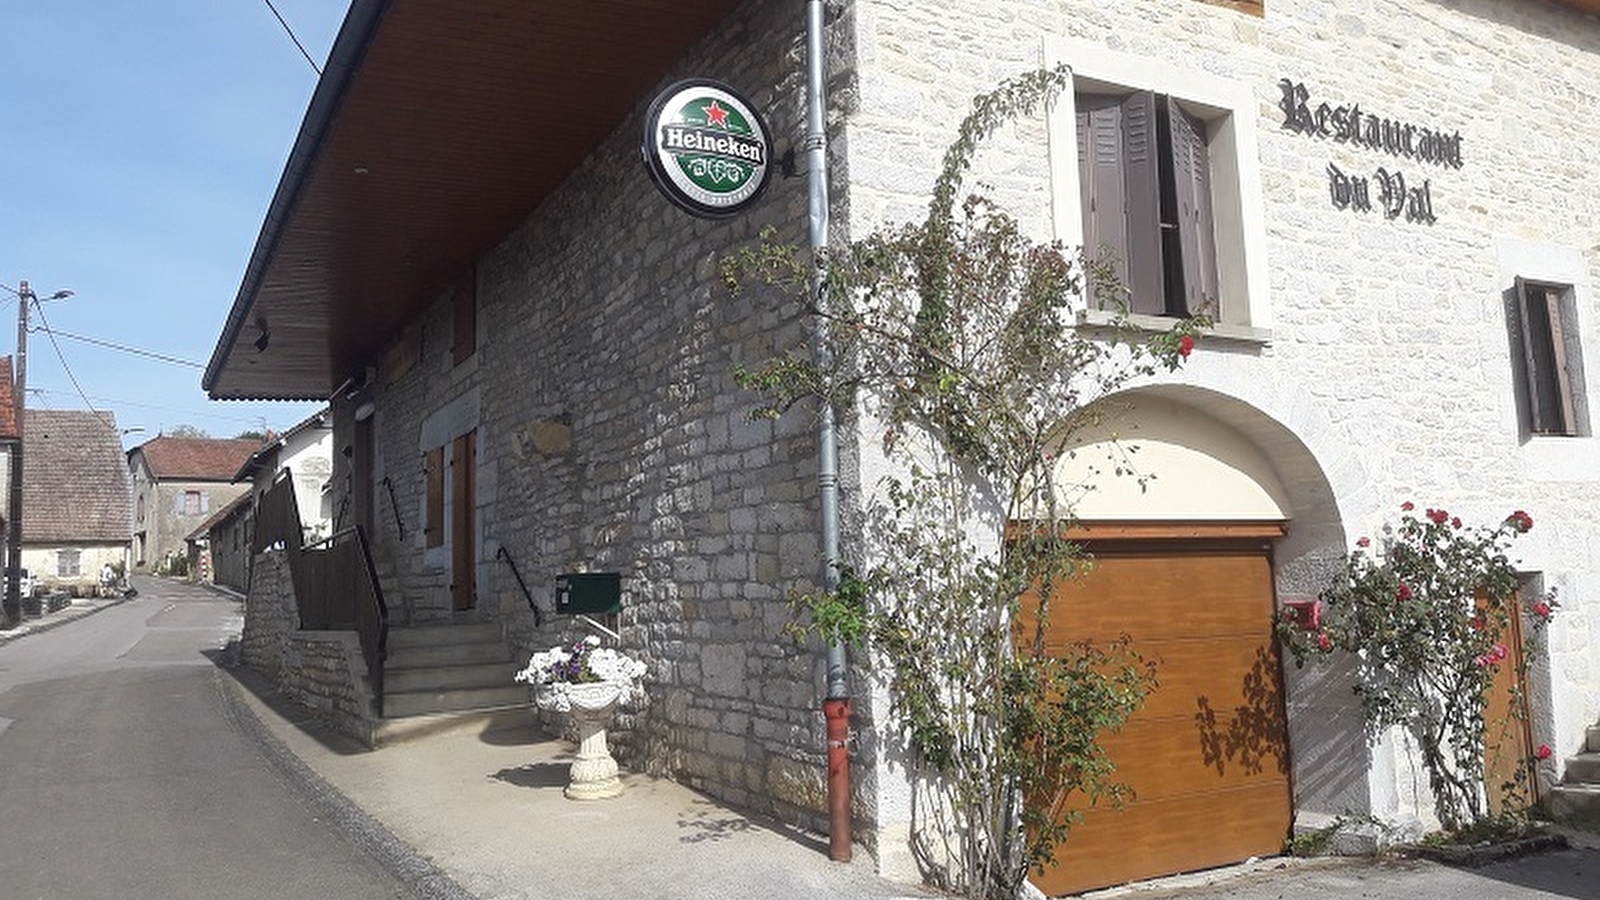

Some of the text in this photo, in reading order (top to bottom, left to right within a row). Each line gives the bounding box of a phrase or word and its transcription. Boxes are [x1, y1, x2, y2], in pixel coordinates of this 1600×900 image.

[666, 128, 761, 161] Heineken
[1277, 78, 1464, 170] Restaurant
[1374, 167, 1437, 226] Val
